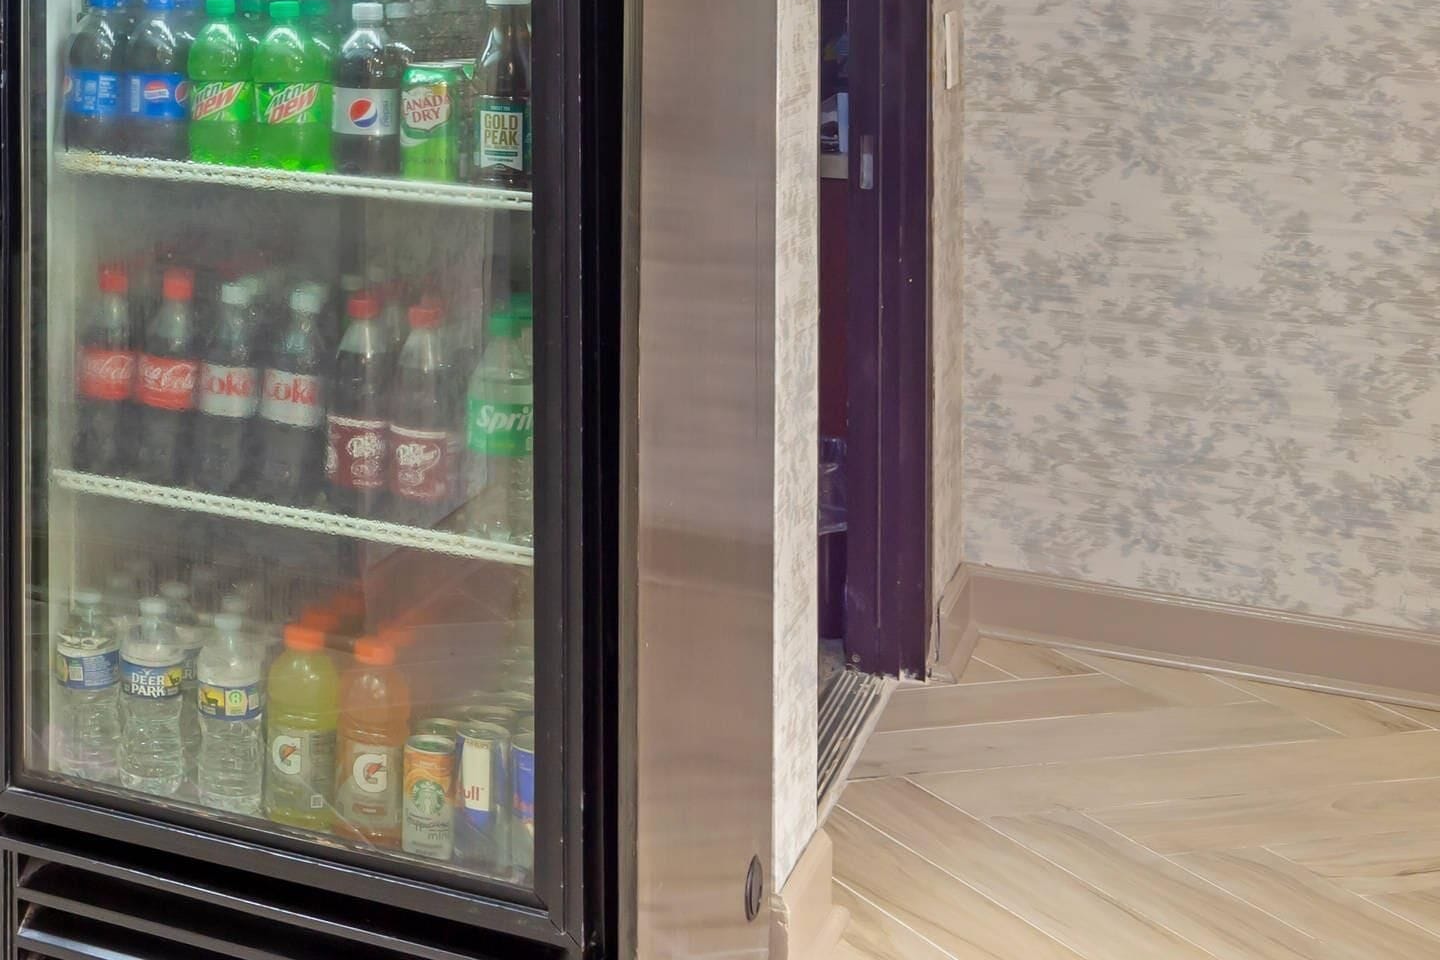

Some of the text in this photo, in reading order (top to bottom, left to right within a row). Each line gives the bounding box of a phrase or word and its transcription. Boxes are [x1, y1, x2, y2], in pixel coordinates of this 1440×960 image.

[412, 108, 441, 123] DRY
[484, 113, 519, 131] GOLD
[484, 129, 520, 146] PEAK
[131, 671, 166, 686] DEER
[131, 683, 166, 698] PARK
[352, 753, 388, 792] G
